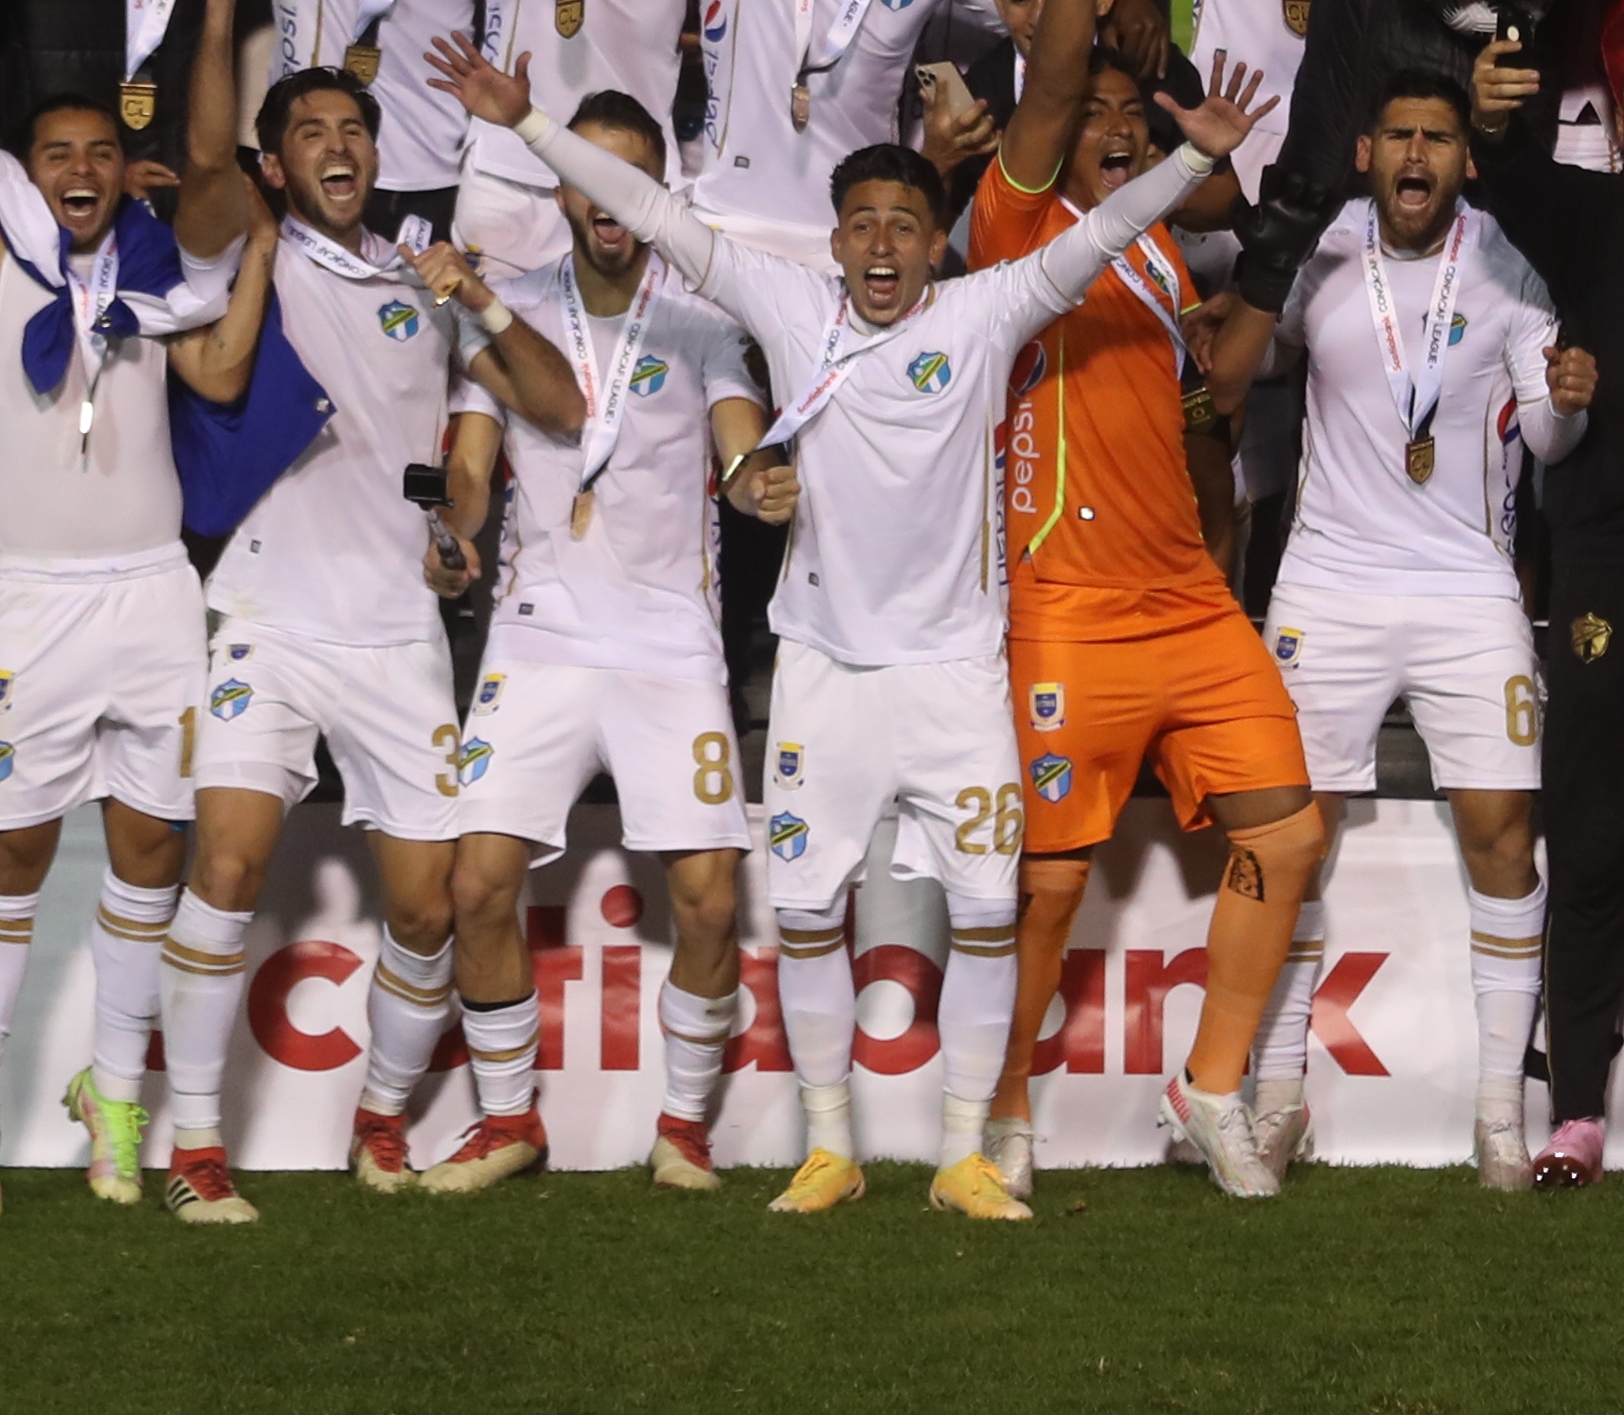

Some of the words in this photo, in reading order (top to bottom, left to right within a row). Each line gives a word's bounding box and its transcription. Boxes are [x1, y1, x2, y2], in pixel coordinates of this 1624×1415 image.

[1435, 264, 1458, 324] CONCACAF
[617, 322, 642, 382] CONCACAF
[1426, 323, 1446, 372] LEAGUE
[602, 379, 623, 426] LEAGUE
[1011, 400, 1041, 514] pepsi
[1504, 676, 1536, 748] 6
[430, 723, 460, 797] 3
[692, 731, 733, 806] 8
[954, 782, 1025, 857] 26
